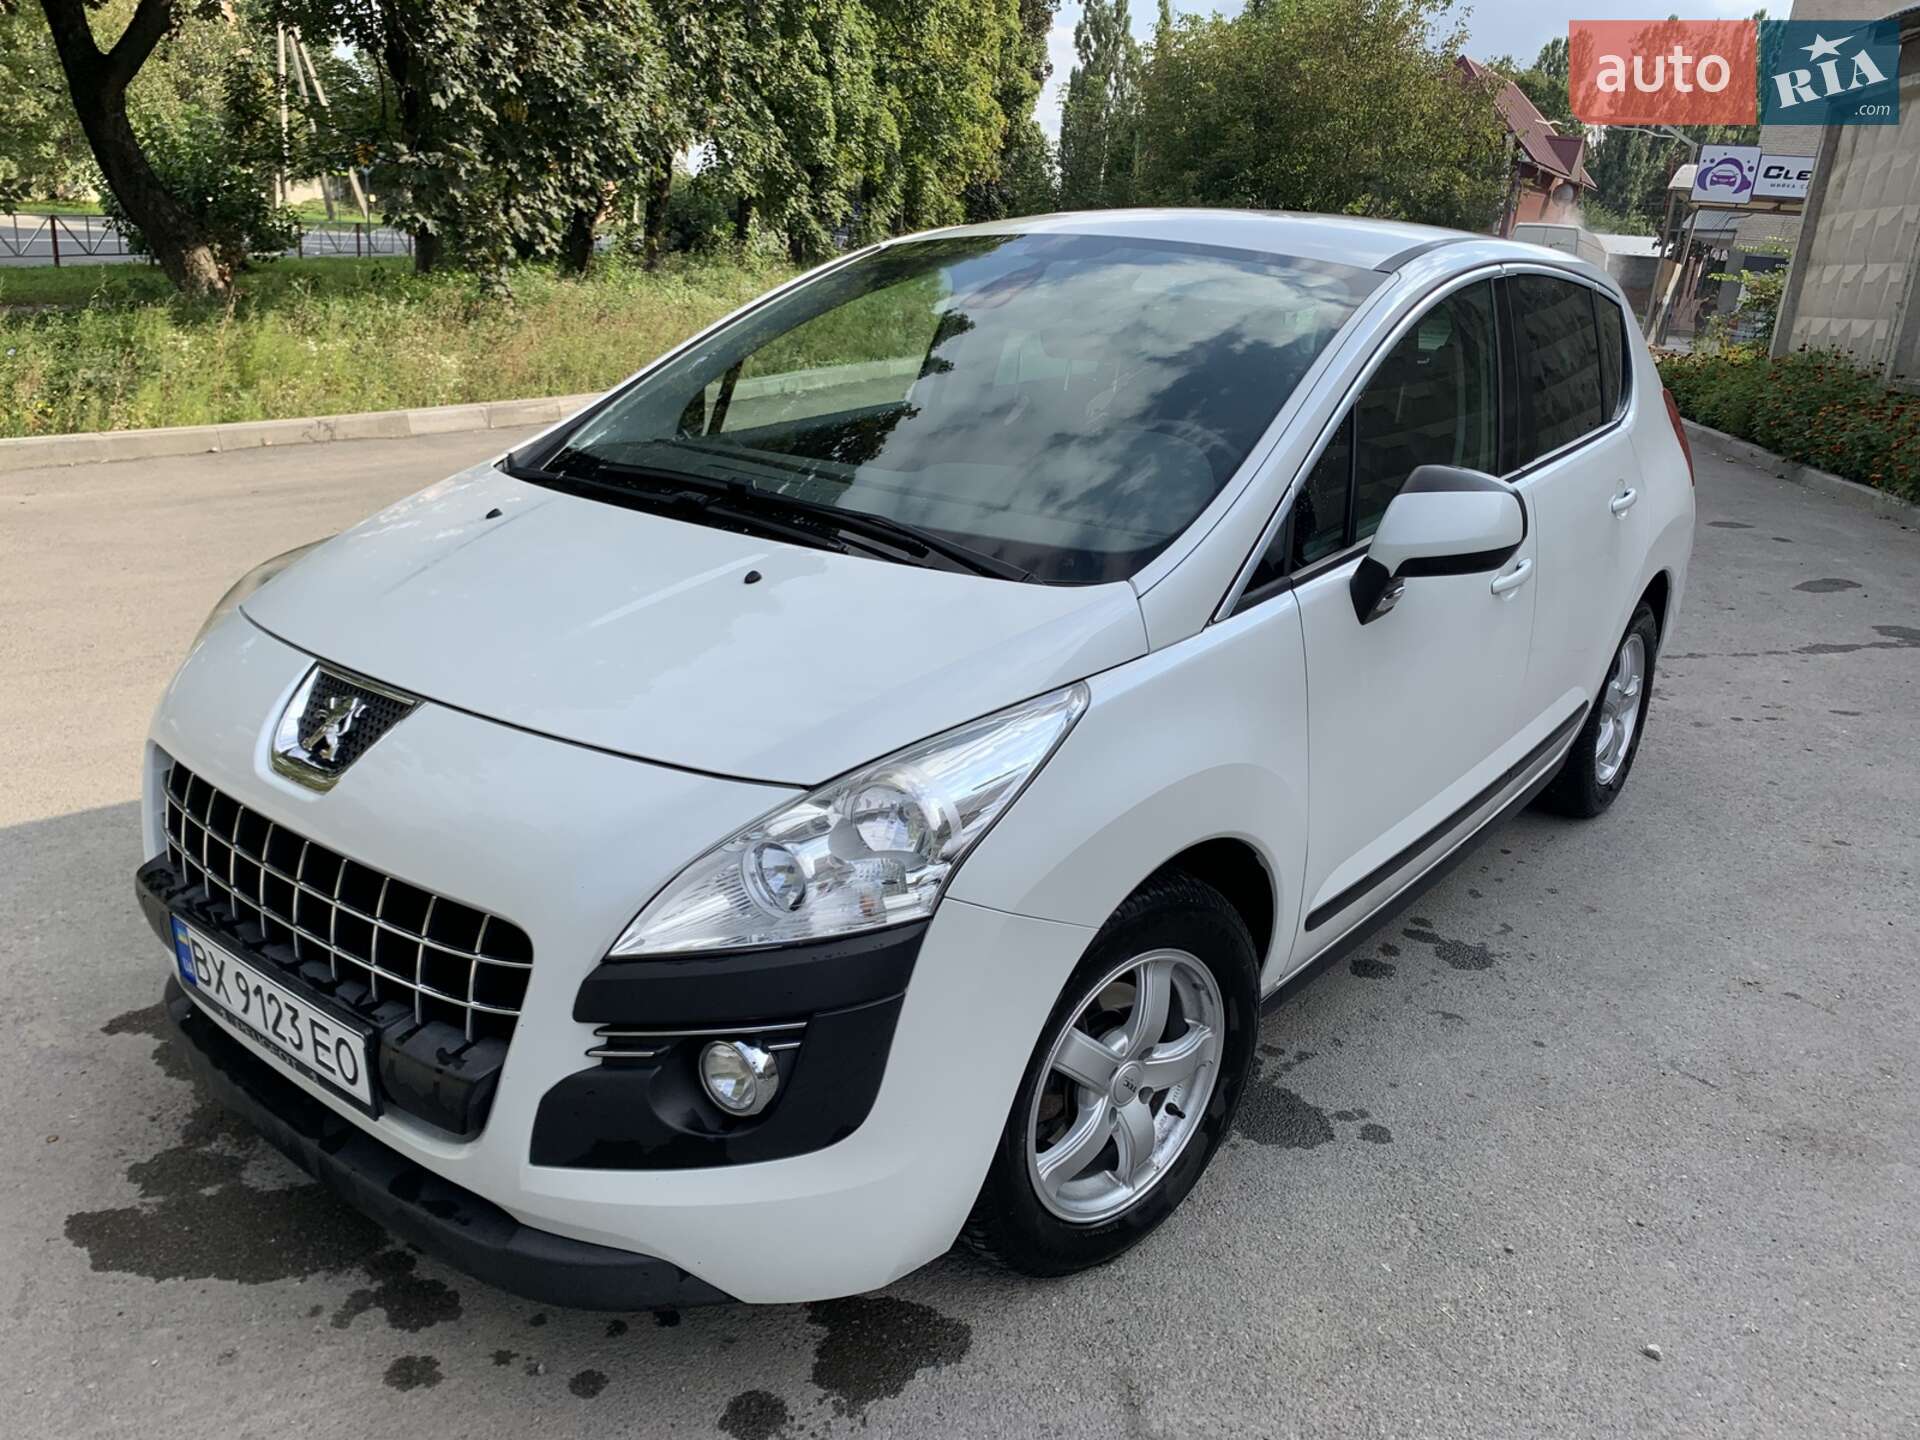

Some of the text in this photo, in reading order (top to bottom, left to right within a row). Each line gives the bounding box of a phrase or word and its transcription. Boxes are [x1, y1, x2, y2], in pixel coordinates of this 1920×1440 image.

[191, 938, 232, 1004] BX
[235, 971, 304, 1051] 9123
[309, 1019, 358, 1086] EO
